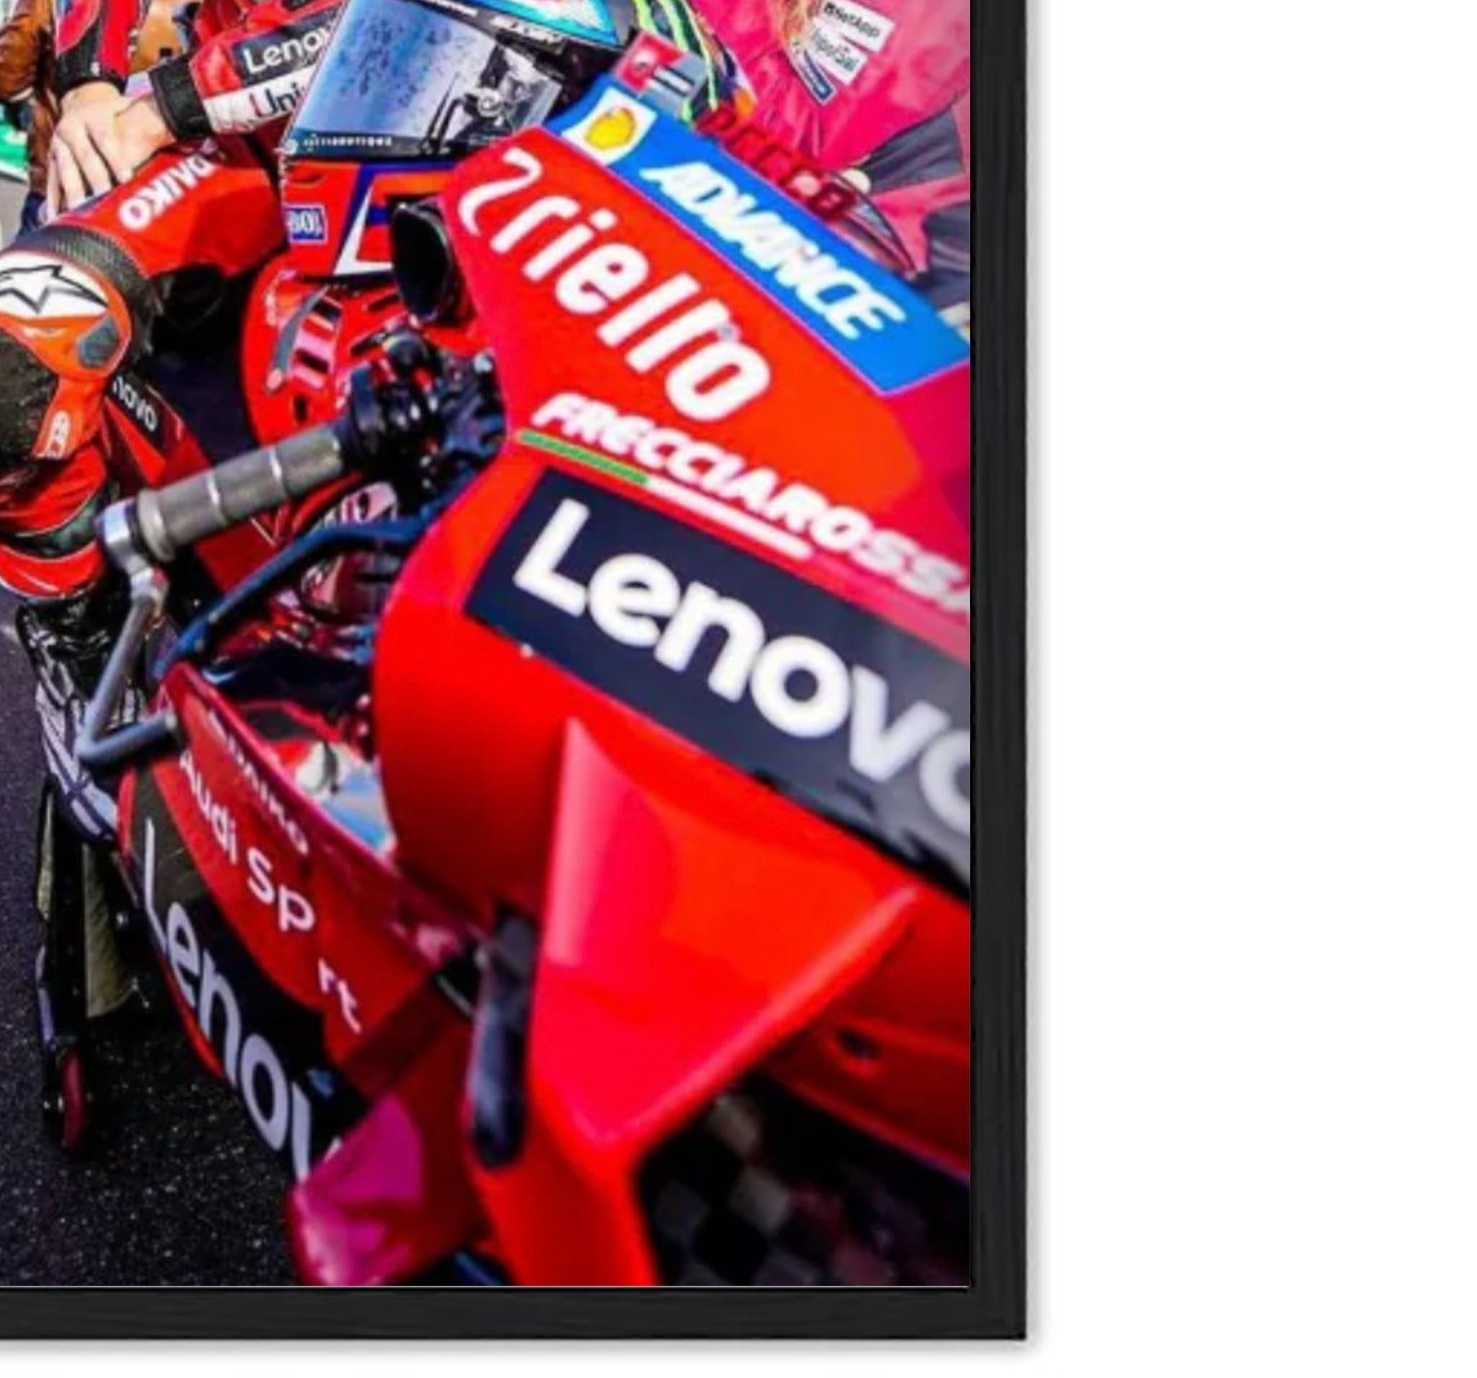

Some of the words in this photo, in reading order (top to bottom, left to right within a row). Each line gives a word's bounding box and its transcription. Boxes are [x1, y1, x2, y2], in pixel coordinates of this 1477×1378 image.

[242, 27, 330, 74] Leno
[118, 154, 218, 232] DAIKO
[638, 161, 907, 341] ADVANCE
[490, 194, 771, 422] riello
[112, 375, 158, 432] novo
[145, 818, 312, 1186] Leno
[246, 846, 361, 1034] Sprt
